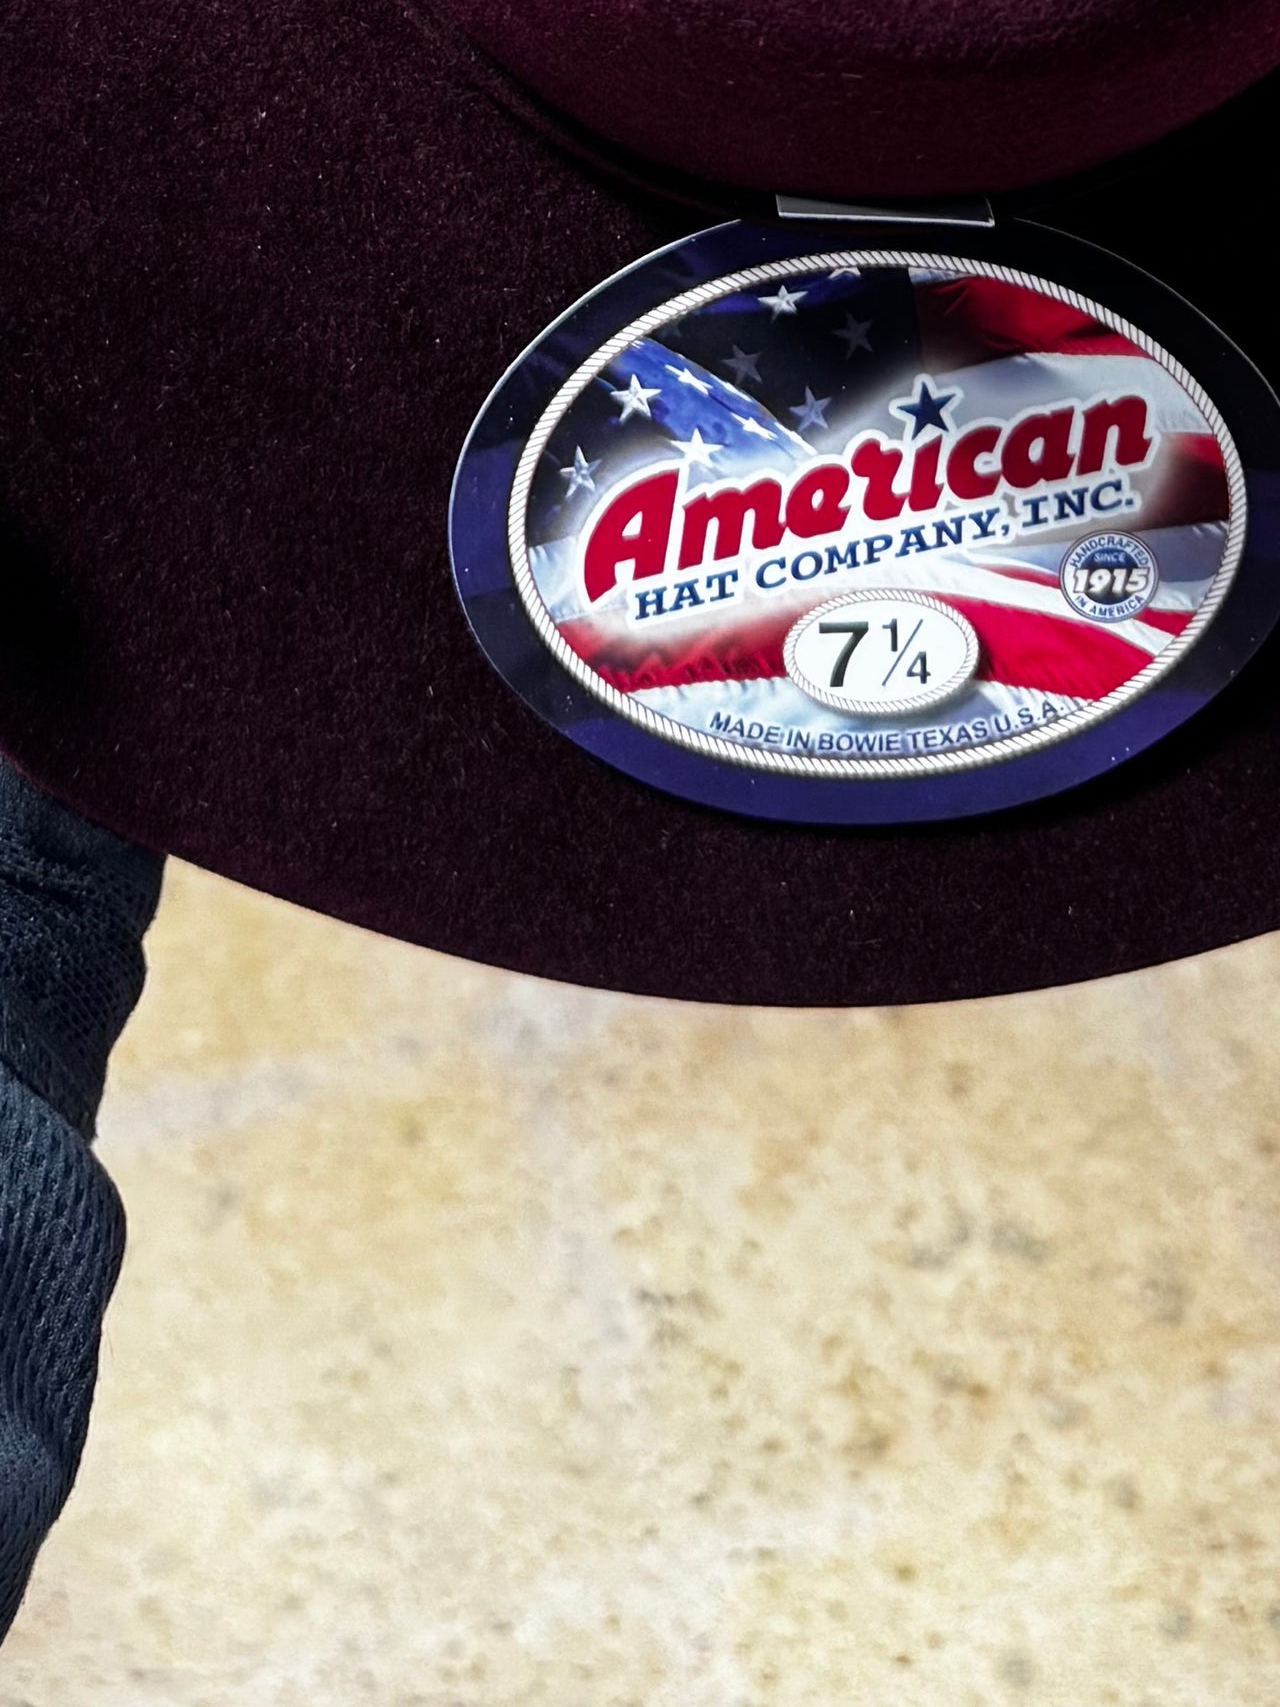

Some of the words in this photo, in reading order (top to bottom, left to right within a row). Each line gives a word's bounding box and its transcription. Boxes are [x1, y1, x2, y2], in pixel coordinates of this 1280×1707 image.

[584, 393, 1152, 603] American
[634, 570, 739, 621] HAT
[756, 505, 1011, 587] COMPANY,
[1021, 479, 1136, 528] INC.
[1069, 535, 1150, 568] HANDCRAFTED
[1093, 552, 1126, 563] SINCE
[1074, 567, 1149, 594] 1915
[1075, 595, 1087, 608] IN
[1089, 594, 1145, 617] AMERICA
[819, 621, 869, 687] 7
[709, 712, 782, 745] MADE
[786, 728, 811, 749] IN
[819, 732, 900, 752] BOWIE
[906, 720, 988, 751] TEXAS
[994, 699, 1064, 734] U.S.A.
